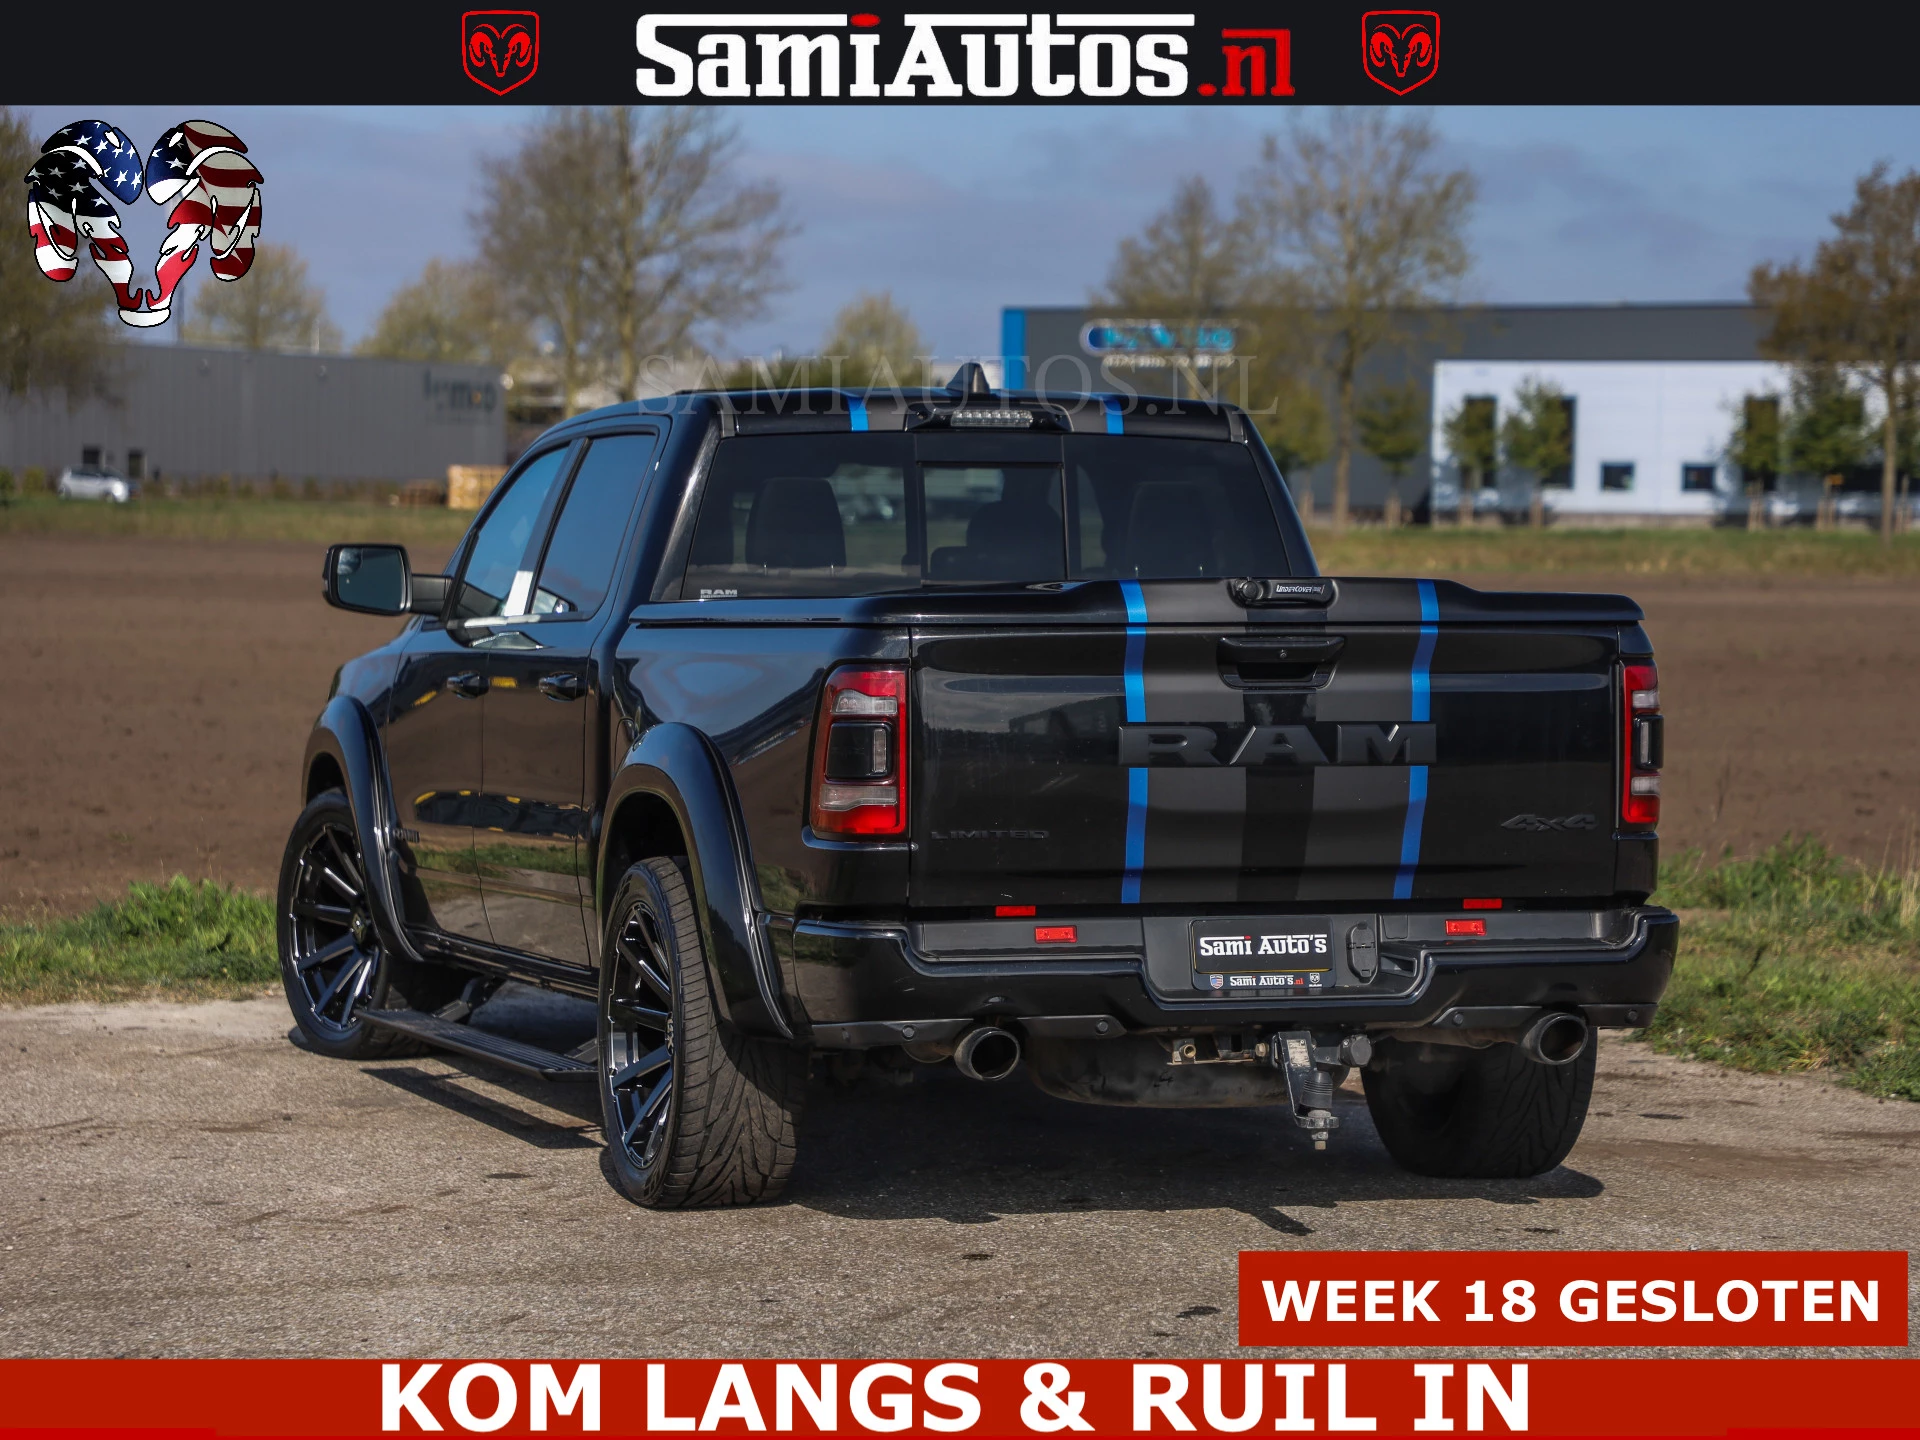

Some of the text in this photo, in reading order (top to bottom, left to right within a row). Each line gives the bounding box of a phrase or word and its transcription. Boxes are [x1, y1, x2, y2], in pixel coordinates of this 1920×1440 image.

[1119, 725, 1437, 765] RAM
[931, 830, 1049, 839] LIMITED
[1200, 934, 1327, 956] Sami Auto's
[1230, 976, 1256, 986] Sami
